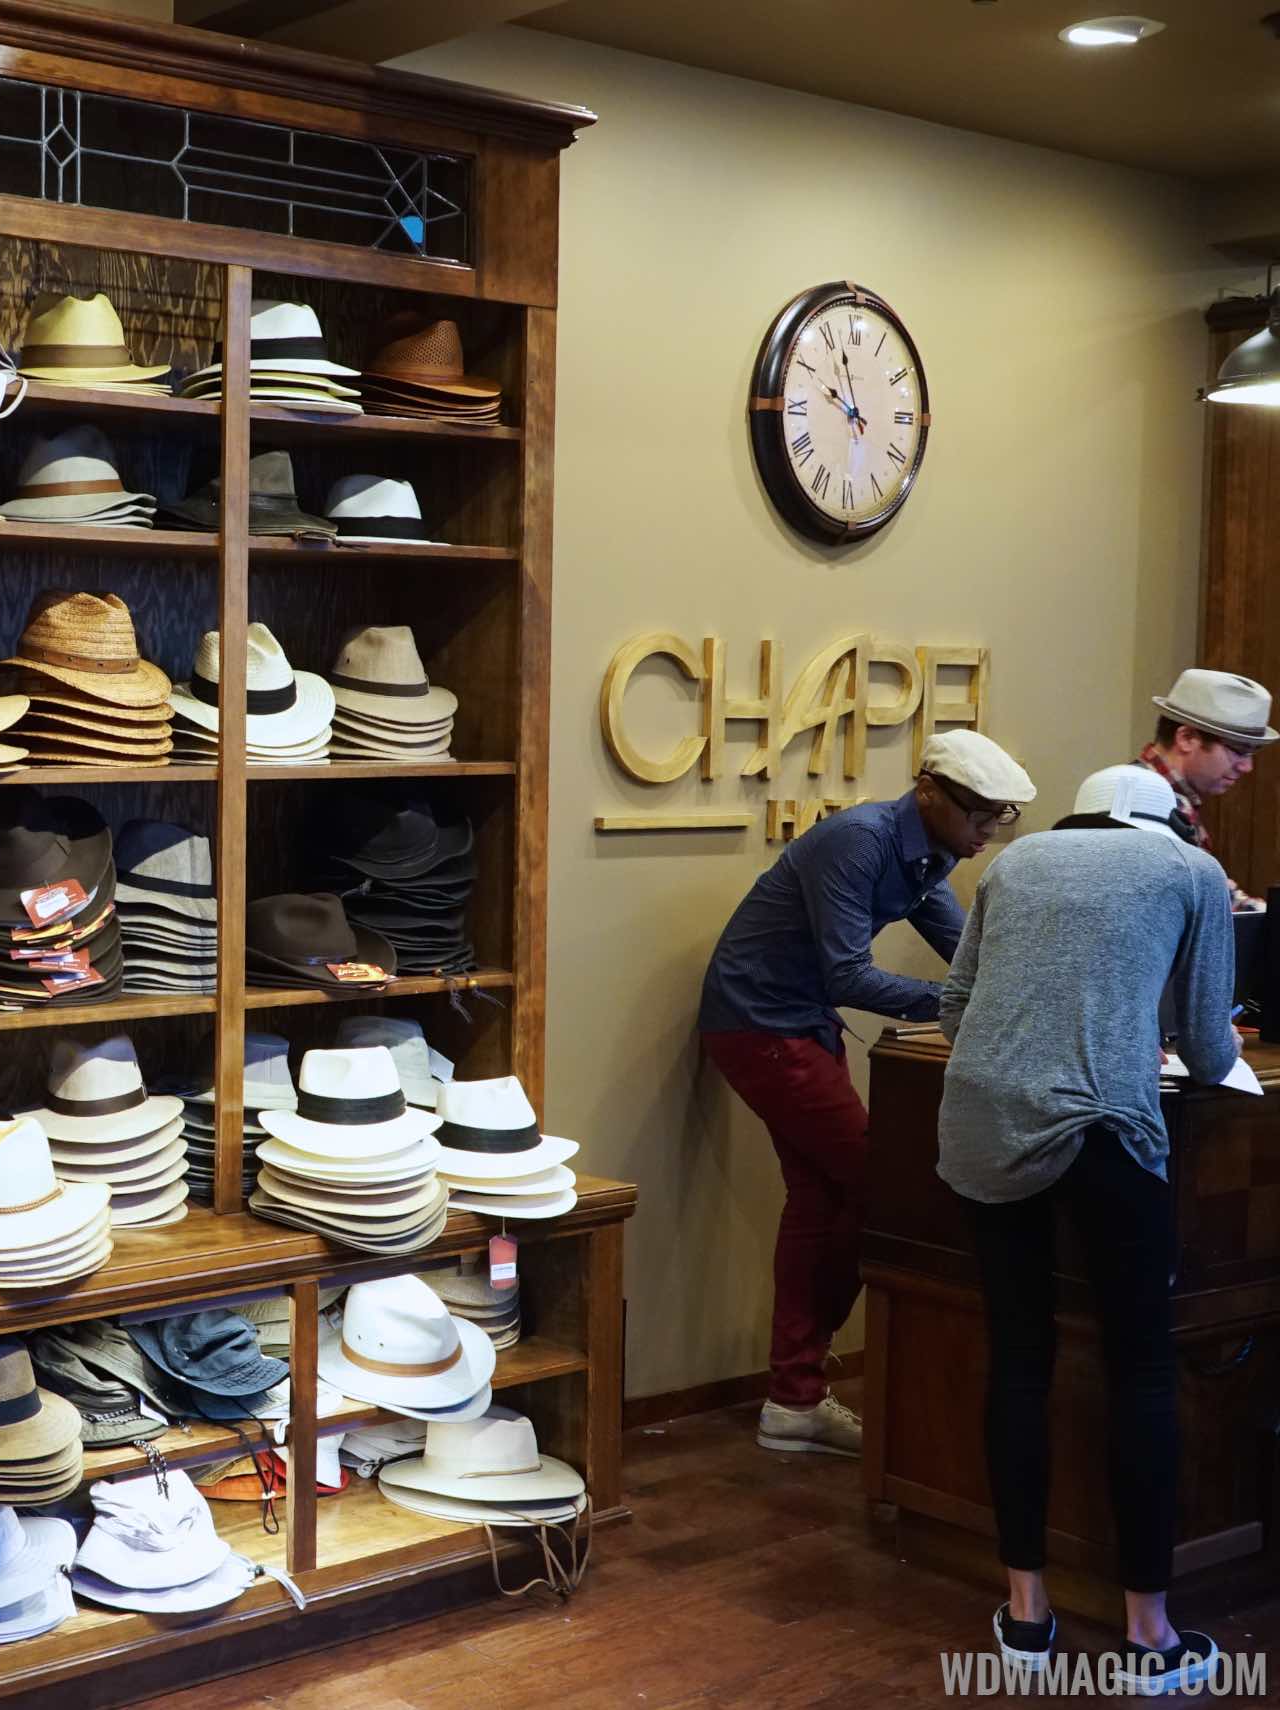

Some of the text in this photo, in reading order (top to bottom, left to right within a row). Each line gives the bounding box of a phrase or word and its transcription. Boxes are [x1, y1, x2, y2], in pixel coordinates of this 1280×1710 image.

[819, 321, 836, 351] XI
[788, 400, 808, 416] IX
[894, 411, 914, 425] III
[792, 432, 815, 468] VIII
[811, 463, 831, 501] VII
[842, 479, 855, 510] VI
